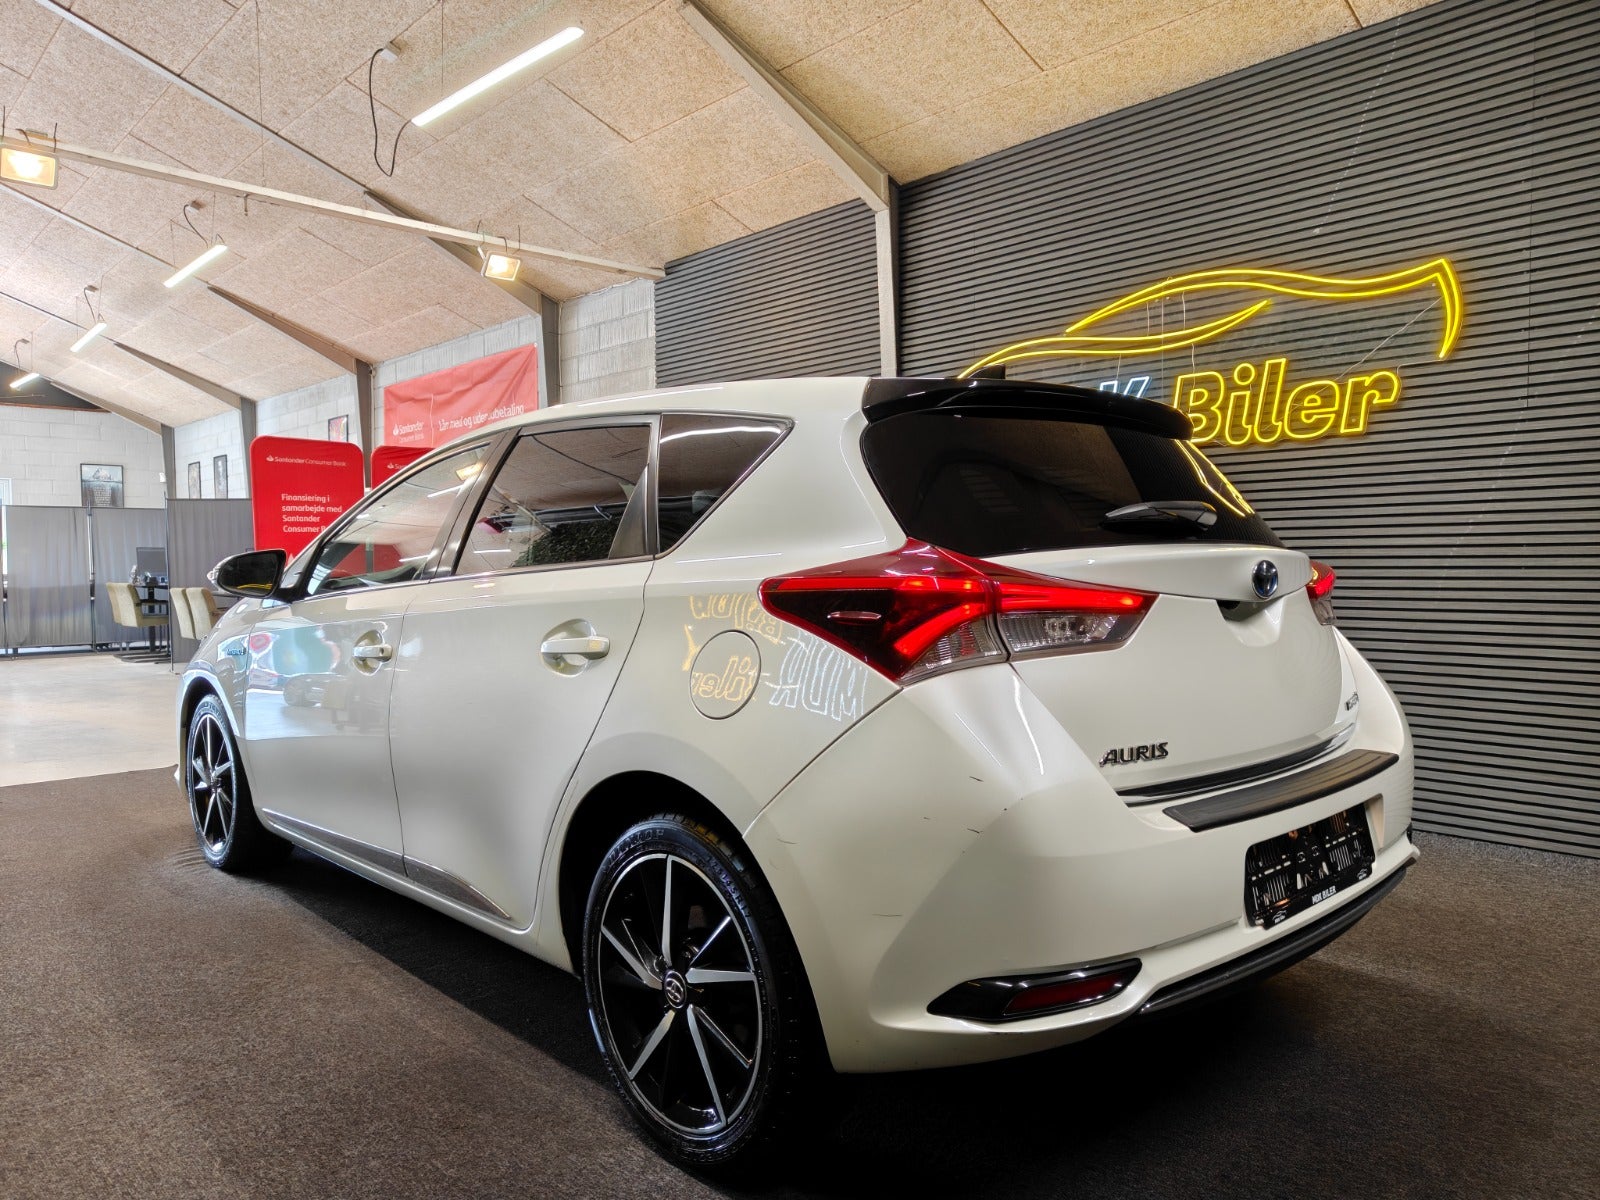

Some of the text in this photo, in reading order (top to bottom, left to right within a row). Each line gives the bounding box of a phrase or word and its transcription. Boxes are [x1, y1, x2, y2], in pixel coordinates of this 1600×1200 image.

[1173, 357, 1402, 447] Biler
[463, 416, 473, 429] og
[273, 456, 305, 464] Santander
[281, 493, 326, 504] Finansiering
[281, 504, 342, 514] samarbejde med
[282, 514, 320, 523] Santander
[282, 525, 320, 533] Consumer
[1099, 742, 1169, 767] AURIS
[1322, 885, 1337, 901] BILER
